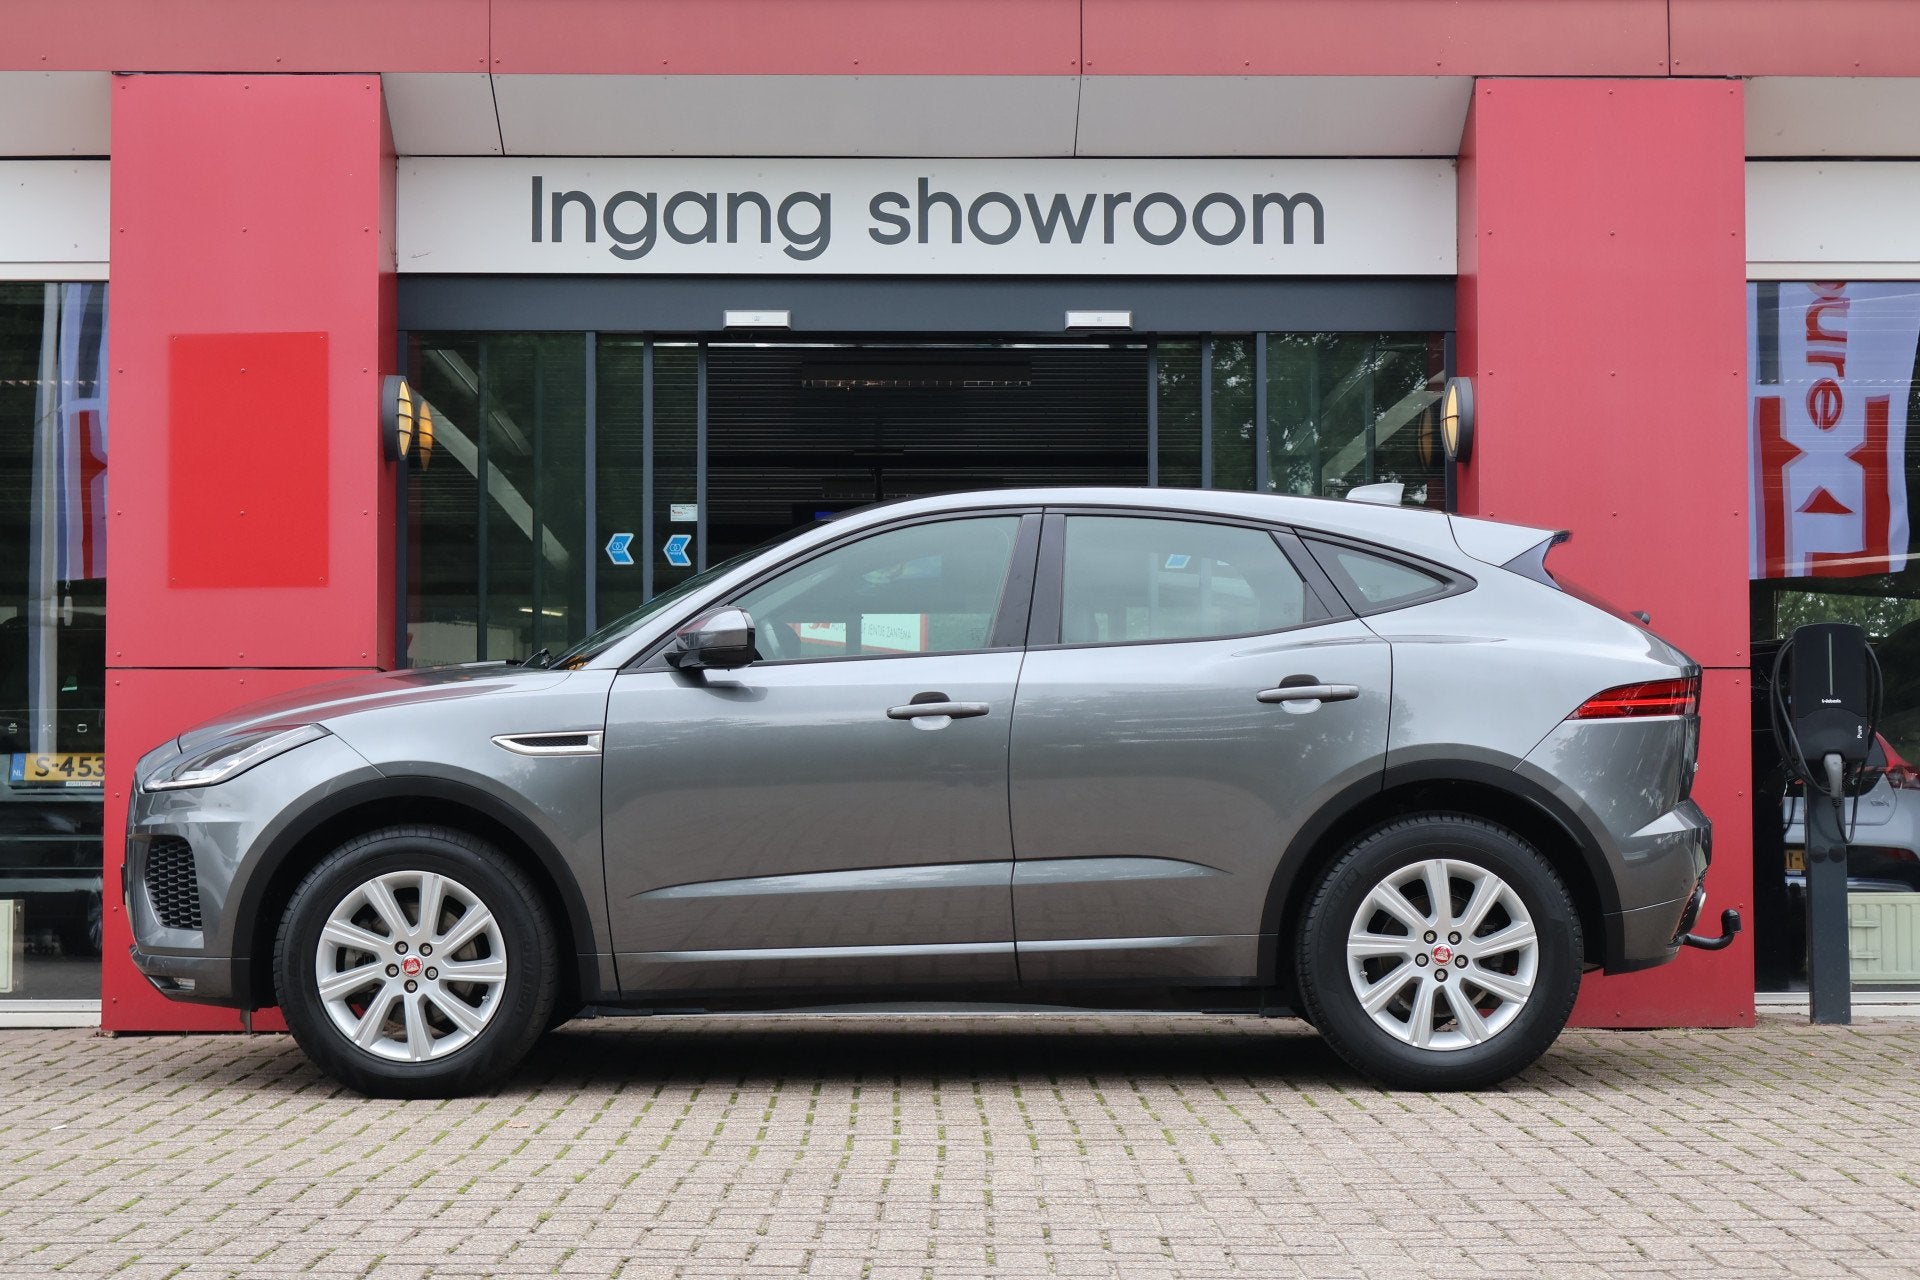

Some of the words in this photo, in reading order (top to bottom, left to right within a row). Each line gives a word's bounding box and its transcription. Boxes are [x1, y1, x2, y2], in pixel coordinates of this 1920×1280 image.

[531, 175, 832, 261] Ingang
[868, 176, 1325, 246] showroom
[12, 769, 22, 777] NL
[35, 756, 104, 777] S-453
